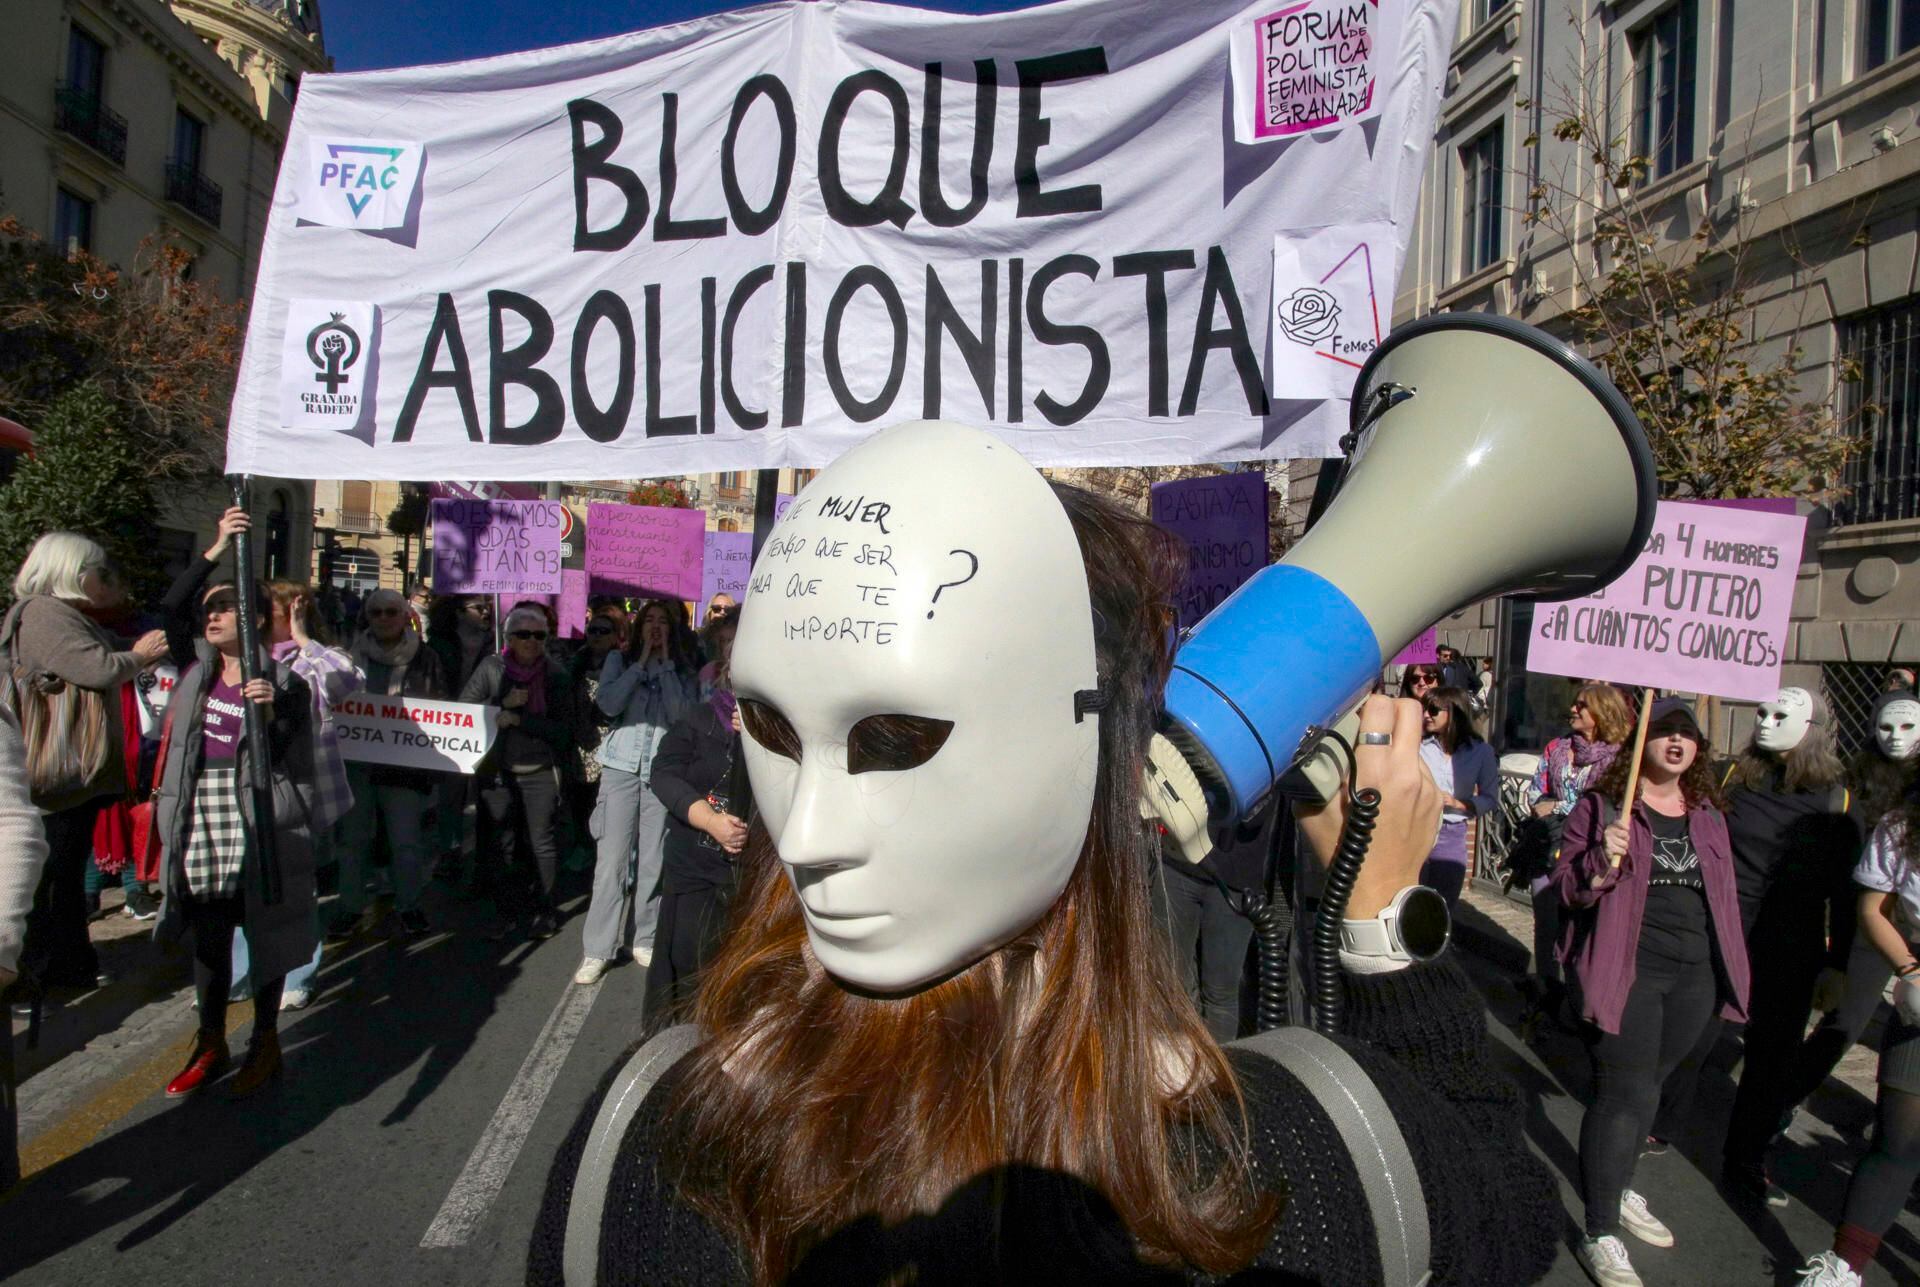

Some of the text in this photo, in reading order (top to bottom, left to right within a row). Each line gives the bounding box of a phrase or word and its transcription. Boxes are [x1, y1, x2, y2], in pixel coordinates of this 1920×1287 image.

[1267, 2, 1368, 54] FORUM DE
[1266, 38, 1368, 78] POLITICA
[1267, 63, 1367, 104] FEMINISTA
[1270, 86, 1368, 128] DE GRANADA
[567, 45, 1109, 252] BLOQUE
[320, 162, 400, 190] PFAC
[393, 245, 1271, 446] ABOLICIONISTA
[300, 392, 358, 404] GRANADA
[305, 403, 354, 415] RADFEM
[436, 501, 560, 529] NO ESTAMOS
[818, 495, 891, 534] MUJER
[467, 526, 530, 549] TODAS
[815, 537, 848, 559] QUE
[854, 543, 897, 576] SER
[1677, 522, 1695, 558] 4
[1703, 539, 1779, 570] HOMBRES
[436, 548, 560, 575] FALTAN 93
[482, 580, 554, 592] FEMINICIDIOS
[786, 573, 822, 598] QUE
[857, 584, 896, 606] TE
[927, 549, 979, 620] ?
[1643, 565, 1762, 621] PUTERO
[784, 616, 898, 645] IMPORTE
[1574, 606, 1672, 653] CUÁNTOS
[382, 705, 474, 728] MACHISTA
[392, 730, 483, 754] TROPICAL
